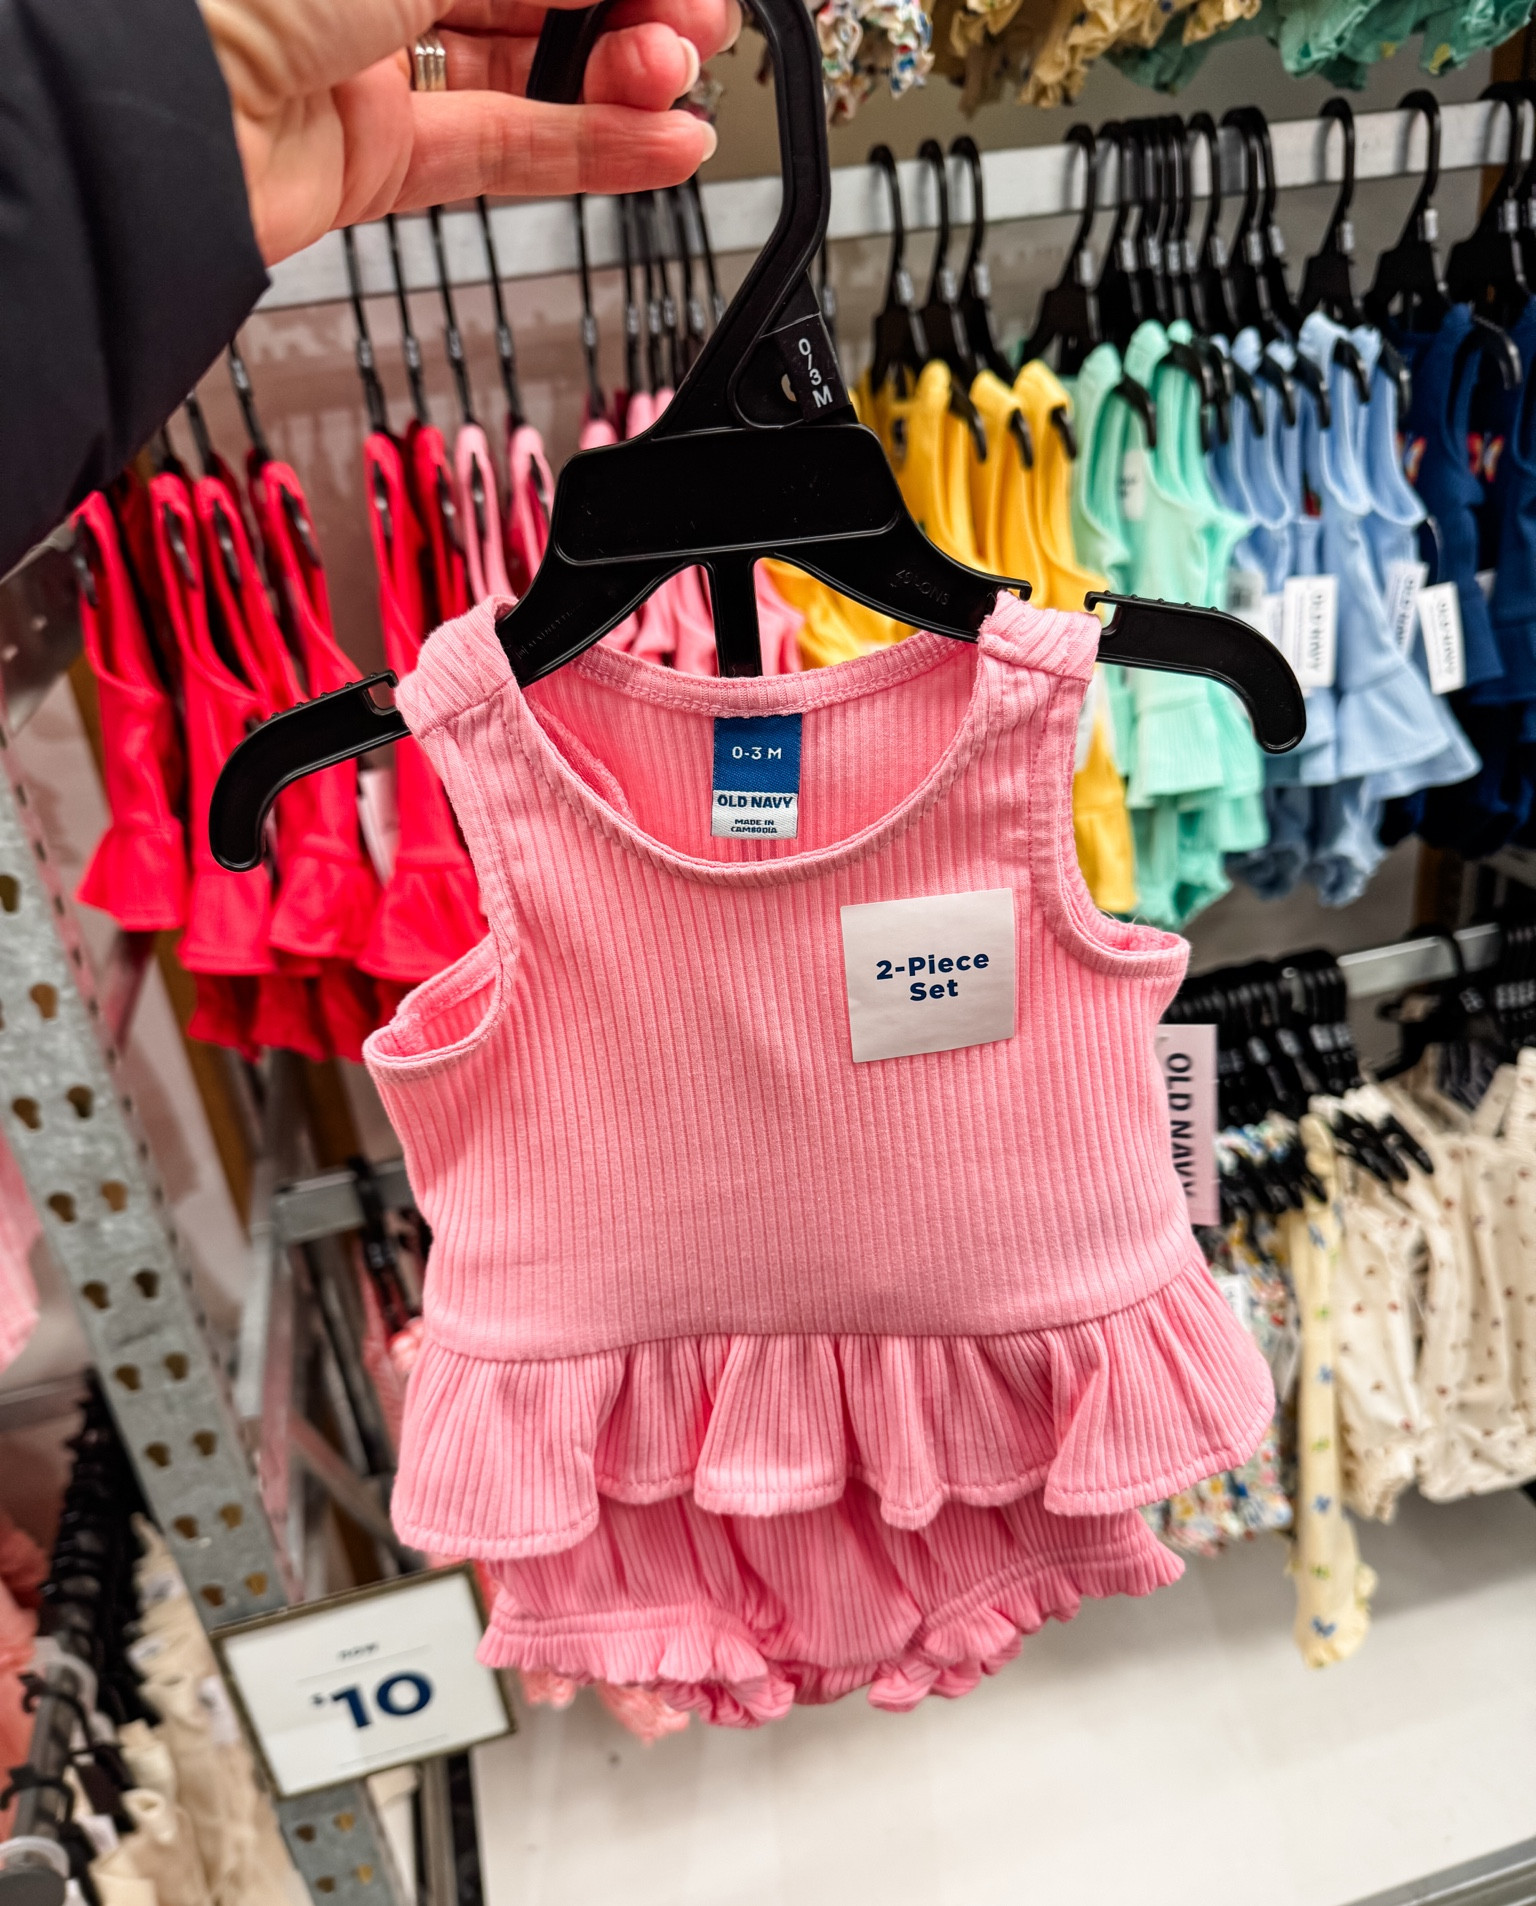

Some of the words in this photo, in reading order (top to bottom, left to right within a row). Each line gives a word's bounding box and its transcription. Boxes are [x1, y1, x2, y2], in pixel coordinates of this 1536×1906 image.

[812, 385, 833, 408] M
[732, 746, 762, 760] 0-3
[767, 747, 782, 759] M
[717, 794, 747, 808] OLD
[750, 796, 793, 809] NAVY
[730, 826, 778, 834] CAMBODIA
[876, 953, 990, 980] 2-Piece
[909, 979, 959, 1002] Set
[1167, 1053, 1193, 1111] OLD
